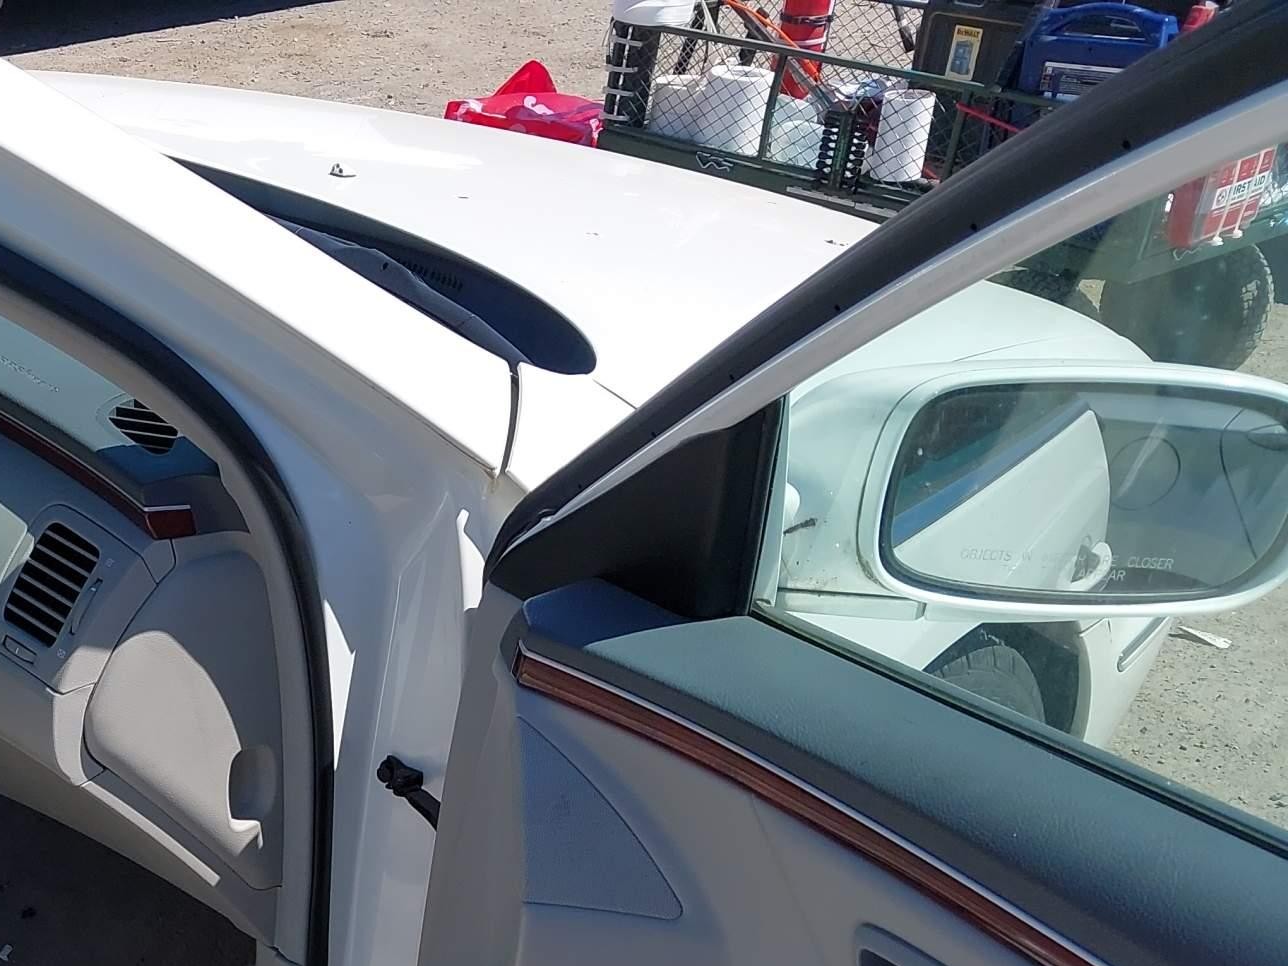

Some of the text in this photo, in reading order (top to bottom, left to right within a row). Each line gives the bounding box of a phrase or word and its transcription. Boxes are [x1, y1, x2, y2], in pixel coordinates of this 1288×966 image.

[1229, 180, 1253, 196] IRST
[959, 547, 1013, 562] OBJECTS
[1127, 555, 1175, 569] CLOSER
